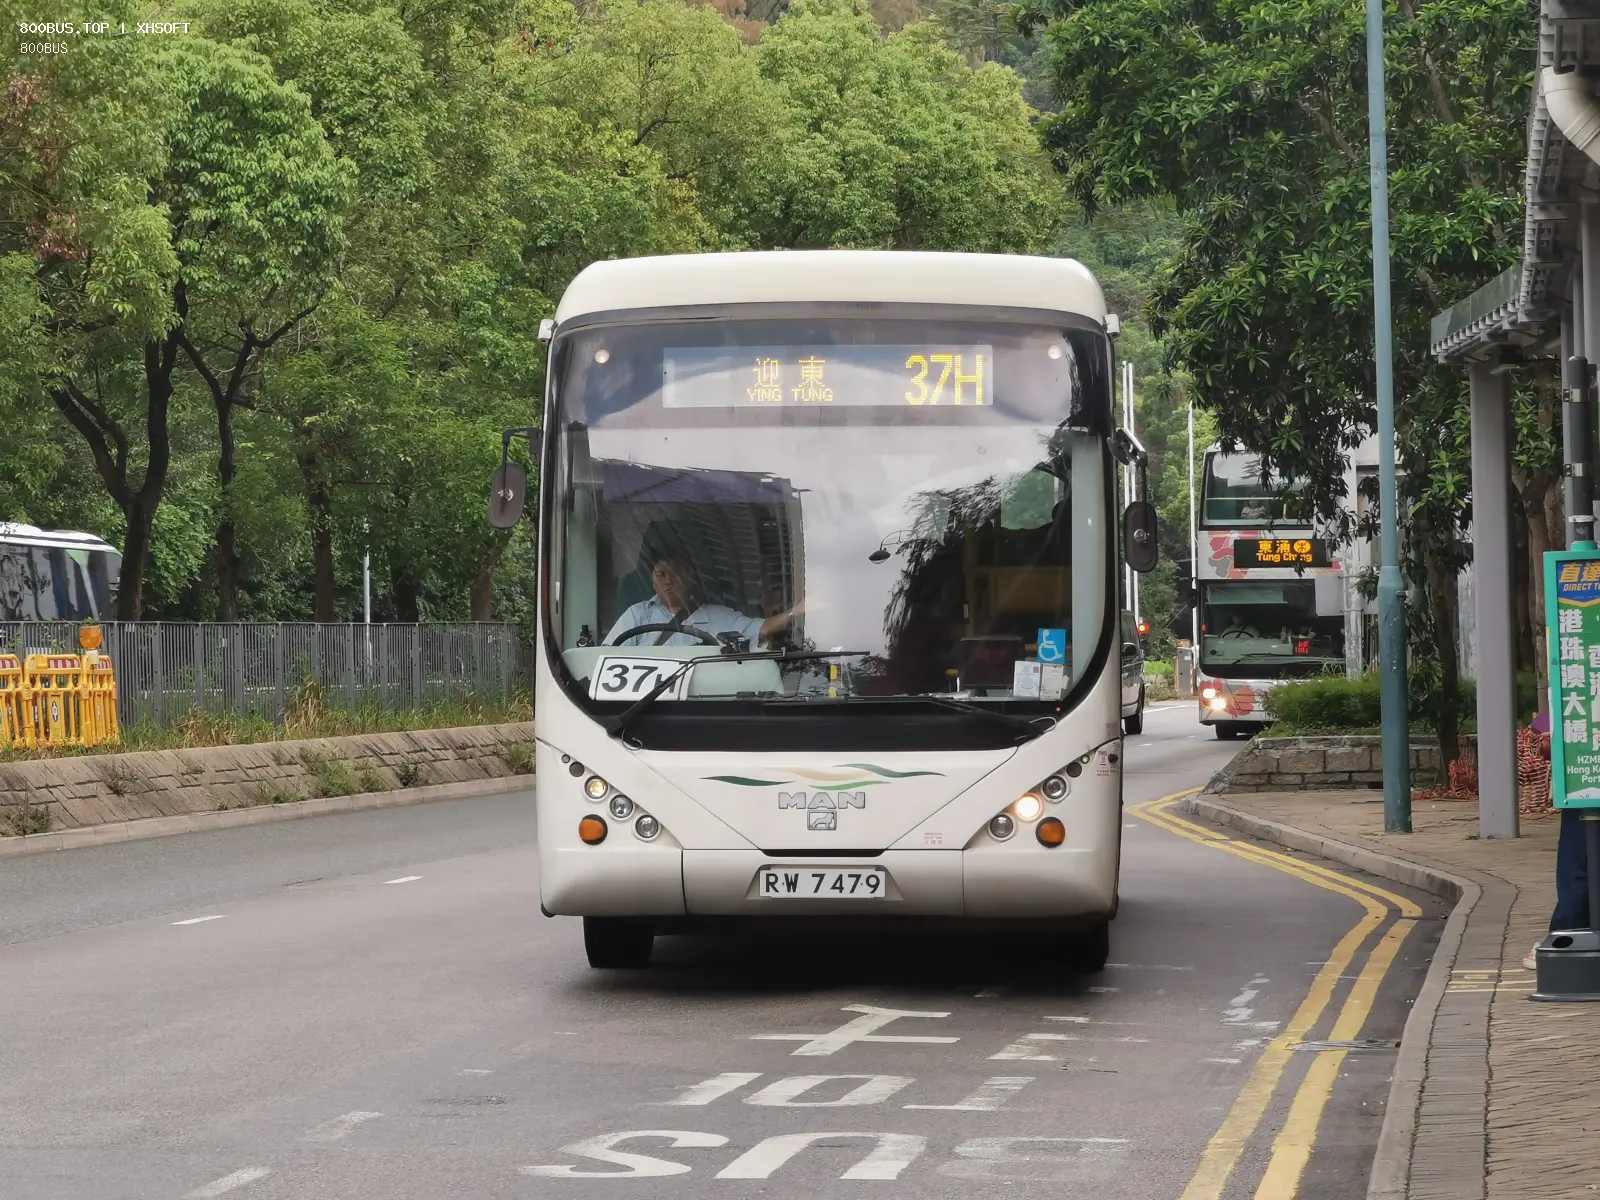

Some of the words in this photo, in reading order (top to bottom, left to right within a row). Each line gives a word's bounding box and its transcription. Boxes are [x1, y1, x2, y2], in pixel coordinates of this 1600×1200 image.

[904, 353, 984, 406] 37H
[746, 387, 782, 402] YING
[791, 387, 833, 402] TUNG
[1258, 540, 1291, 553] 東涌
[1256, 552, 1280, 563] Tung
[1563, 583, 1592, 592] DIRECT
[1559, 608, 1588, 744] 港珠澳大橋
[1566, 765, 1590, 775] Hong
[778, 791, 866, 809] MAN
[765, 873, 799, 893] RW
[811, 873, 881, 893] 7479
